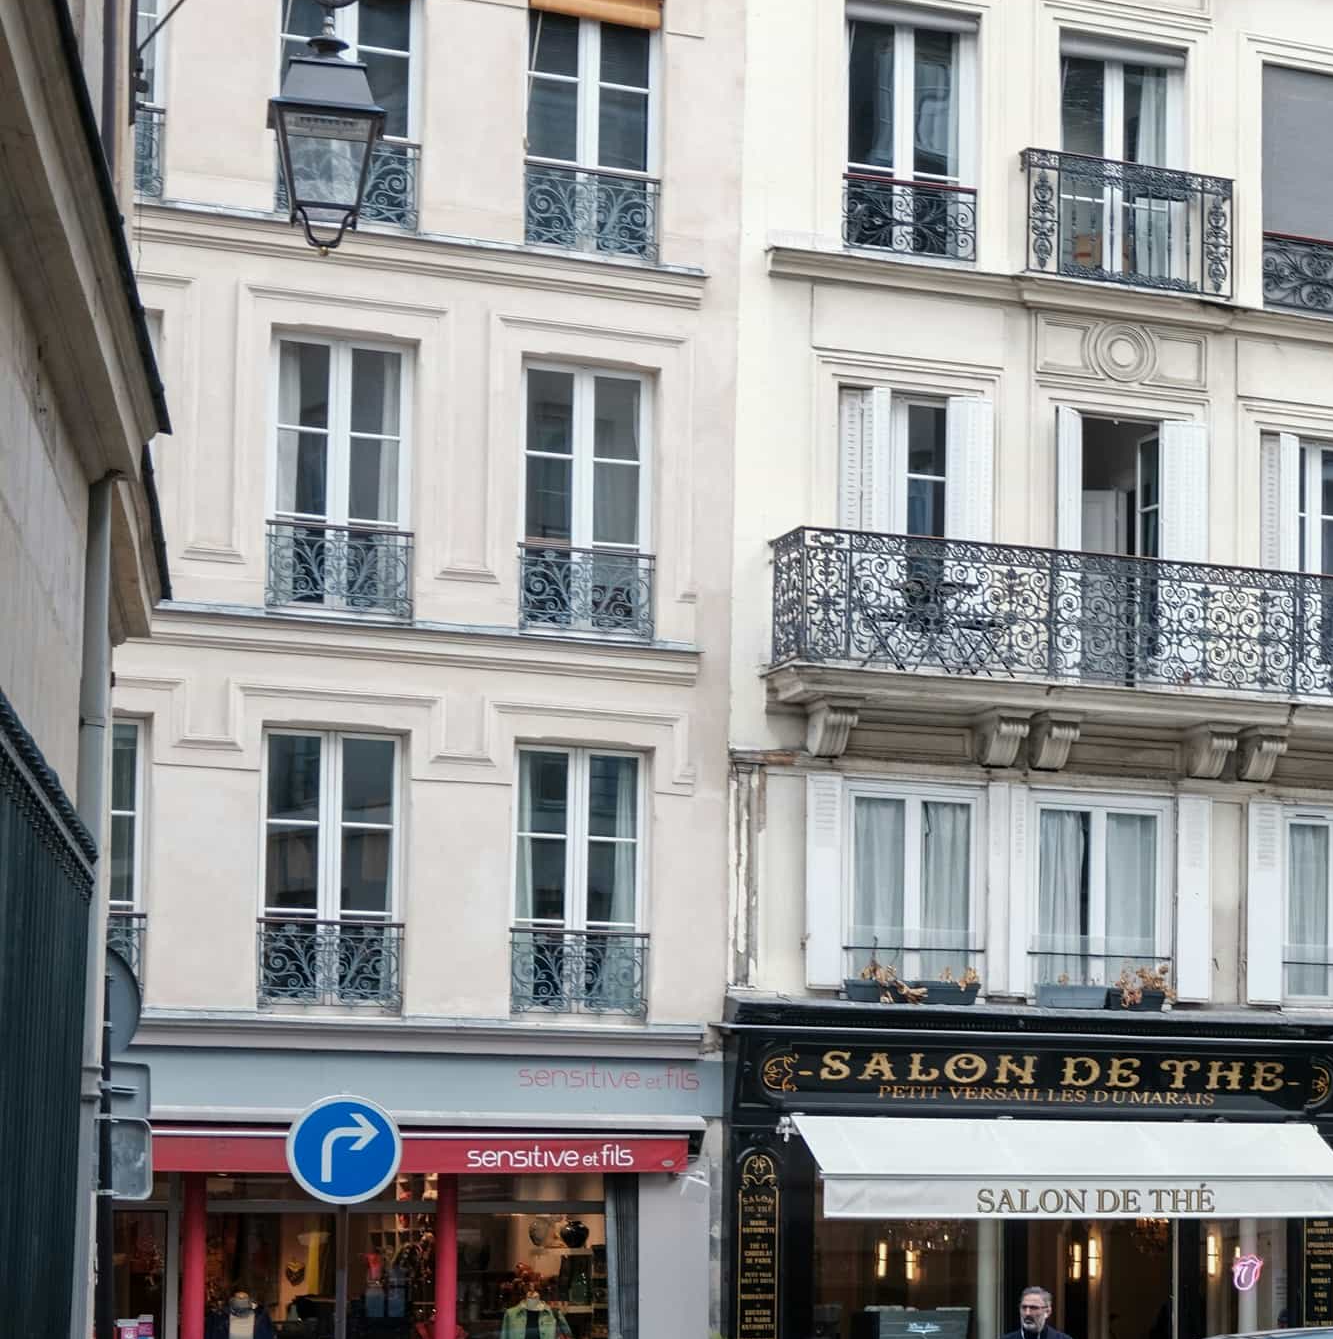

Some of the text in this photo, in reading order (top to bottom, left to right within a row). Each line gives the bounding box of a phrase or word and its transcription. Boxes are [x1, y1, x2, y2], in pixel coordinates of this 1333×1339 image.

[517, 1064, 641, 1090] sensitive
[664, 1066, 701, 1092] fils
[819, 1049, 1286, 1093] SALON DE THE
[878, 1084, 943, 1100] PETIT
[466, 1144, 635, 1168] sensitive et fils
[976, 1182, 1216, 1214] SALON DE THÉ
